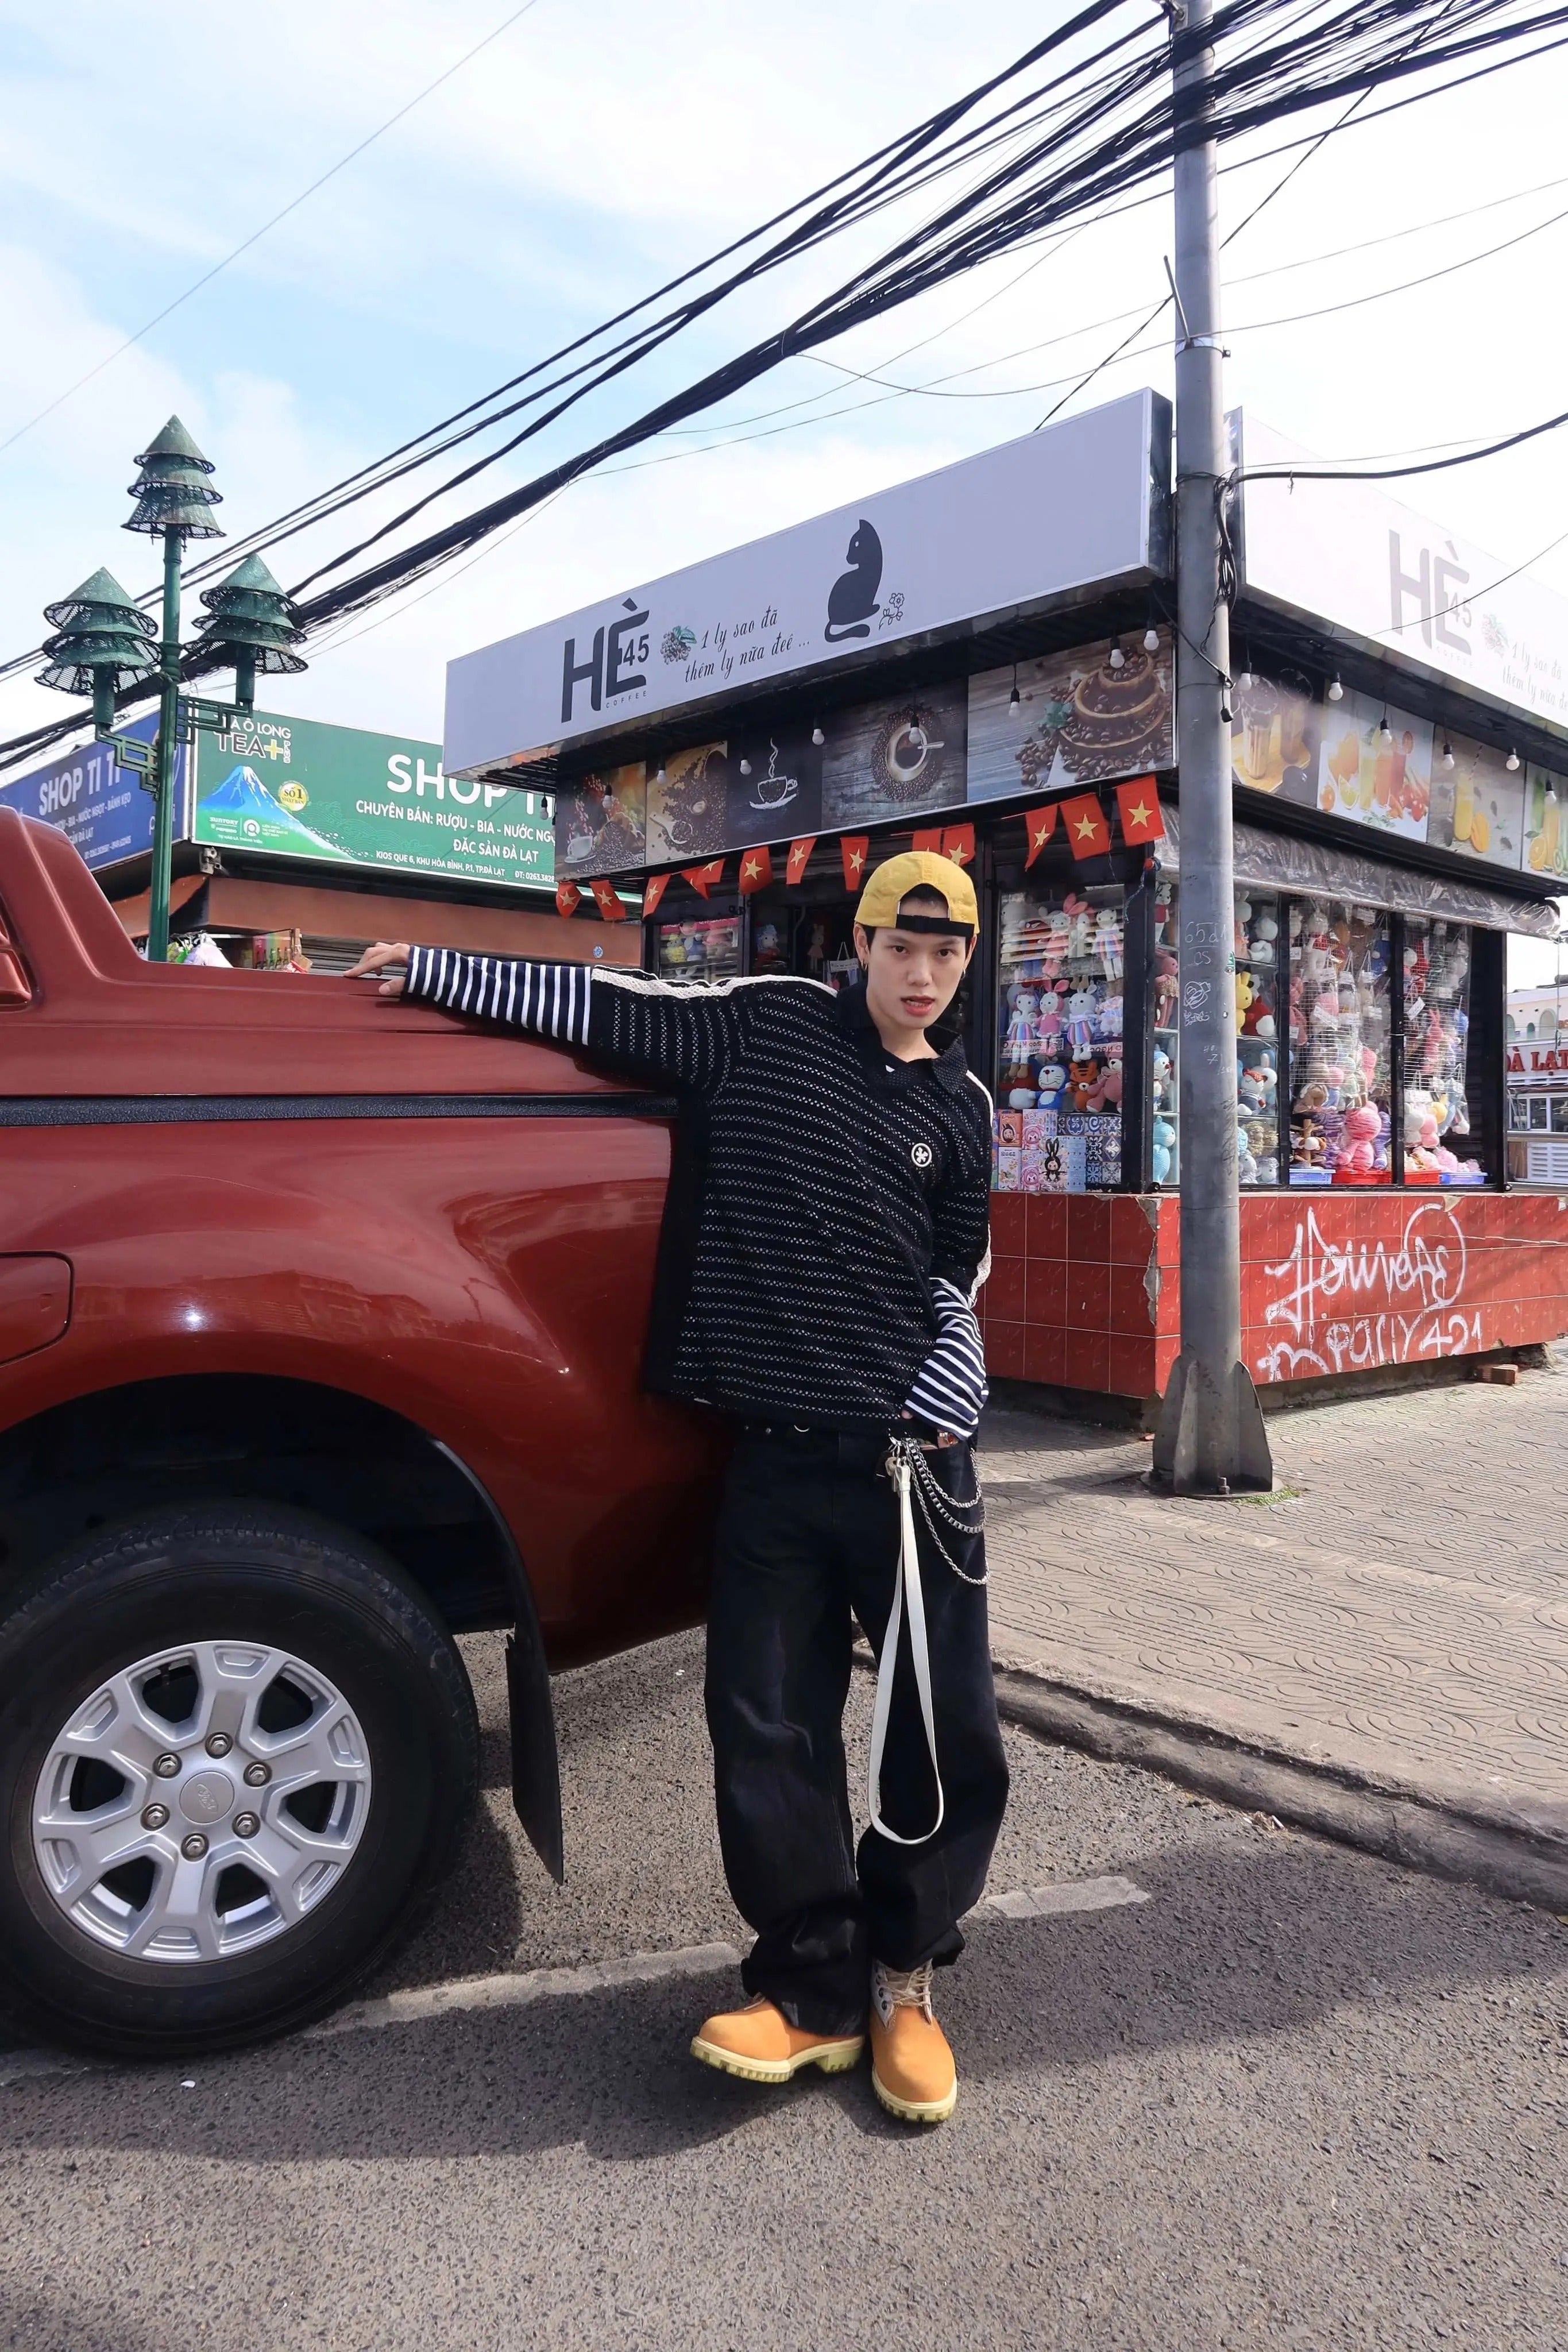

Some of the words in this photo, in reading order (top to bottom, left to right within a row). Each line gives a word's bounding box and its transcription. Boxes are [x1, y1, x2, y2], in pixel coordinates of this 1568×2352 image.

[701, 630, 709, 650] 1
[714, 622, 727, 652] ly
[733, 620, 755, 638] sao
[761, 605, 778, 627] đã
[561, 597, 650, 723] HÈ
[622, 634, 650, 666] 45
[685, 659, 715, 682] thêm
[721, 649, 733, 680] ly
[740, 647, 766, 666] nữa
[606, 690, 647, 708] COFFEE
[244, 717, 254, 732] Ô
[257, 722, 292, 739] LONG
[283, 740, 291, 763] PLUS
[39, 767, 83, 816] SHOP
[87, 756, 101, 795] TI
[297, 789, 303, 799] 1
[387, 754, 508, 808] SHOP
[356, 800, 403, 820] CHUYÊN
[407, 806, 433, 824] BÁN:
[436, 813, 468, 833] RƯỢU
[477, 820, 495, 834] BIA
[504, 823, 534, 840] NƯỚC
[376, 850, 393, 860] KIOS
[393, 853, 408, 863] QUE
[416, 856, 431, 866] KHU
[431, 857, 446, 868] HÒA
[493, 867, 505, 878] LẠT
[515, 870, 525, 879] ĐT:
[453, 836, 477, 854] ĐẶC
[478, 840, 500, 858] SẢN
[503, 844, 517, 860] ĐÀ
[520, 849, 539, 865] LẠT
[1531, 1050, 1568, 1076] LẠT
